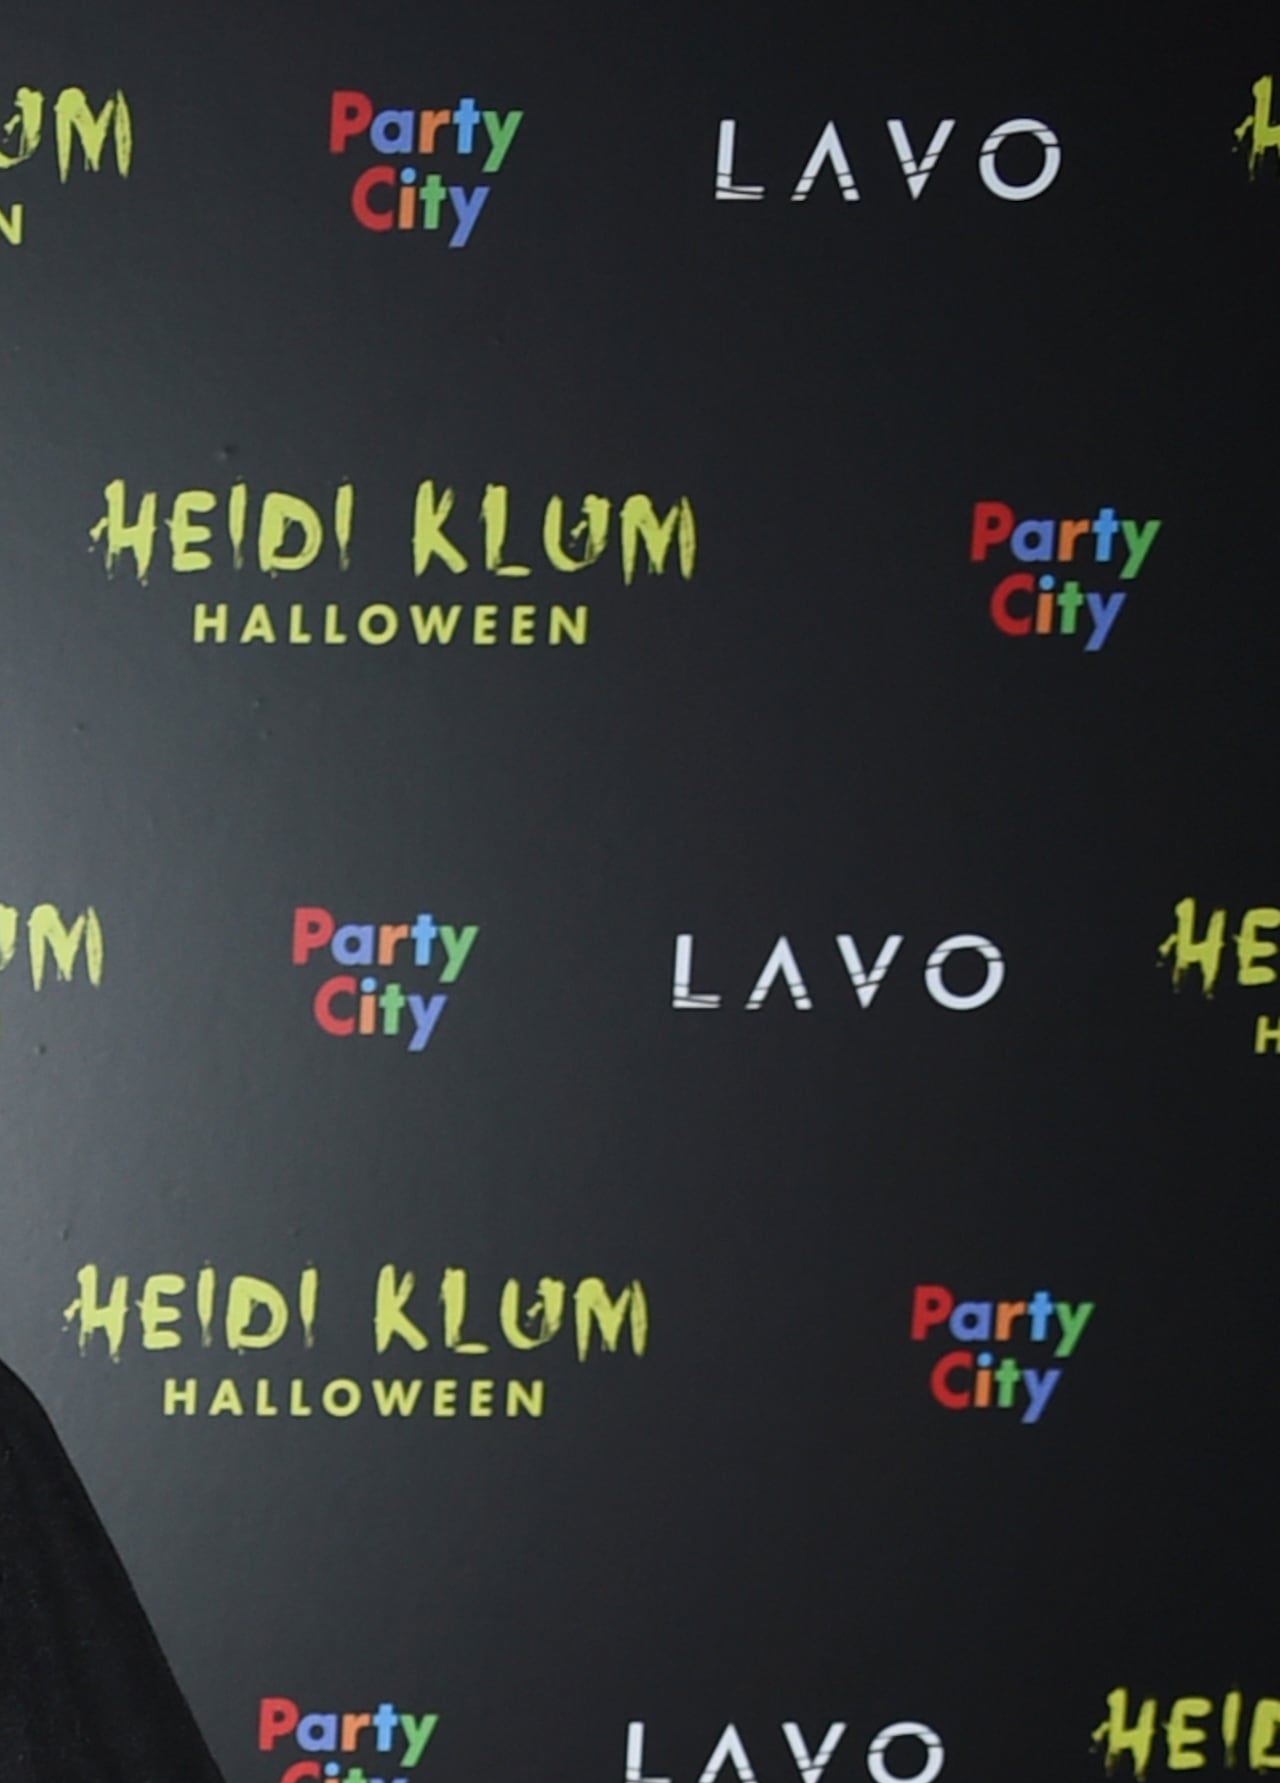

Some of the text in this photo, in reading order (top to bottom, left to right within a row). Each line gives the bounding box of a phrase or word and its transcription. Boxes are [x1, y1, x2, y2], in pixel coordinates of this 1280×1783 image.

[330, 90, 523, 172] Party
[715, 118, 1061, 201] LAVO
[352, 165, 490, 247] City
[90, 480, 696, 585] HEIDI KLUM
[971, 501, 1161, 579] Party
[194, 604, 587, 644] HALLOWEEN
[990, 572, 1126, 651] City
[293, 907, 478, 982] Party
[673, 934, 1005, 1010] LAVO
[314, 975, 447, 1051] City
[63, 1264, 647, 1362] HEIDI KLUM
[911, 1285, 1094, 1357] Party
[164, 1379, 543, 1417] HALLOWEEN
[930, 1350, 1062, 1423] City
[258, 1697, 438, 1767] Party
